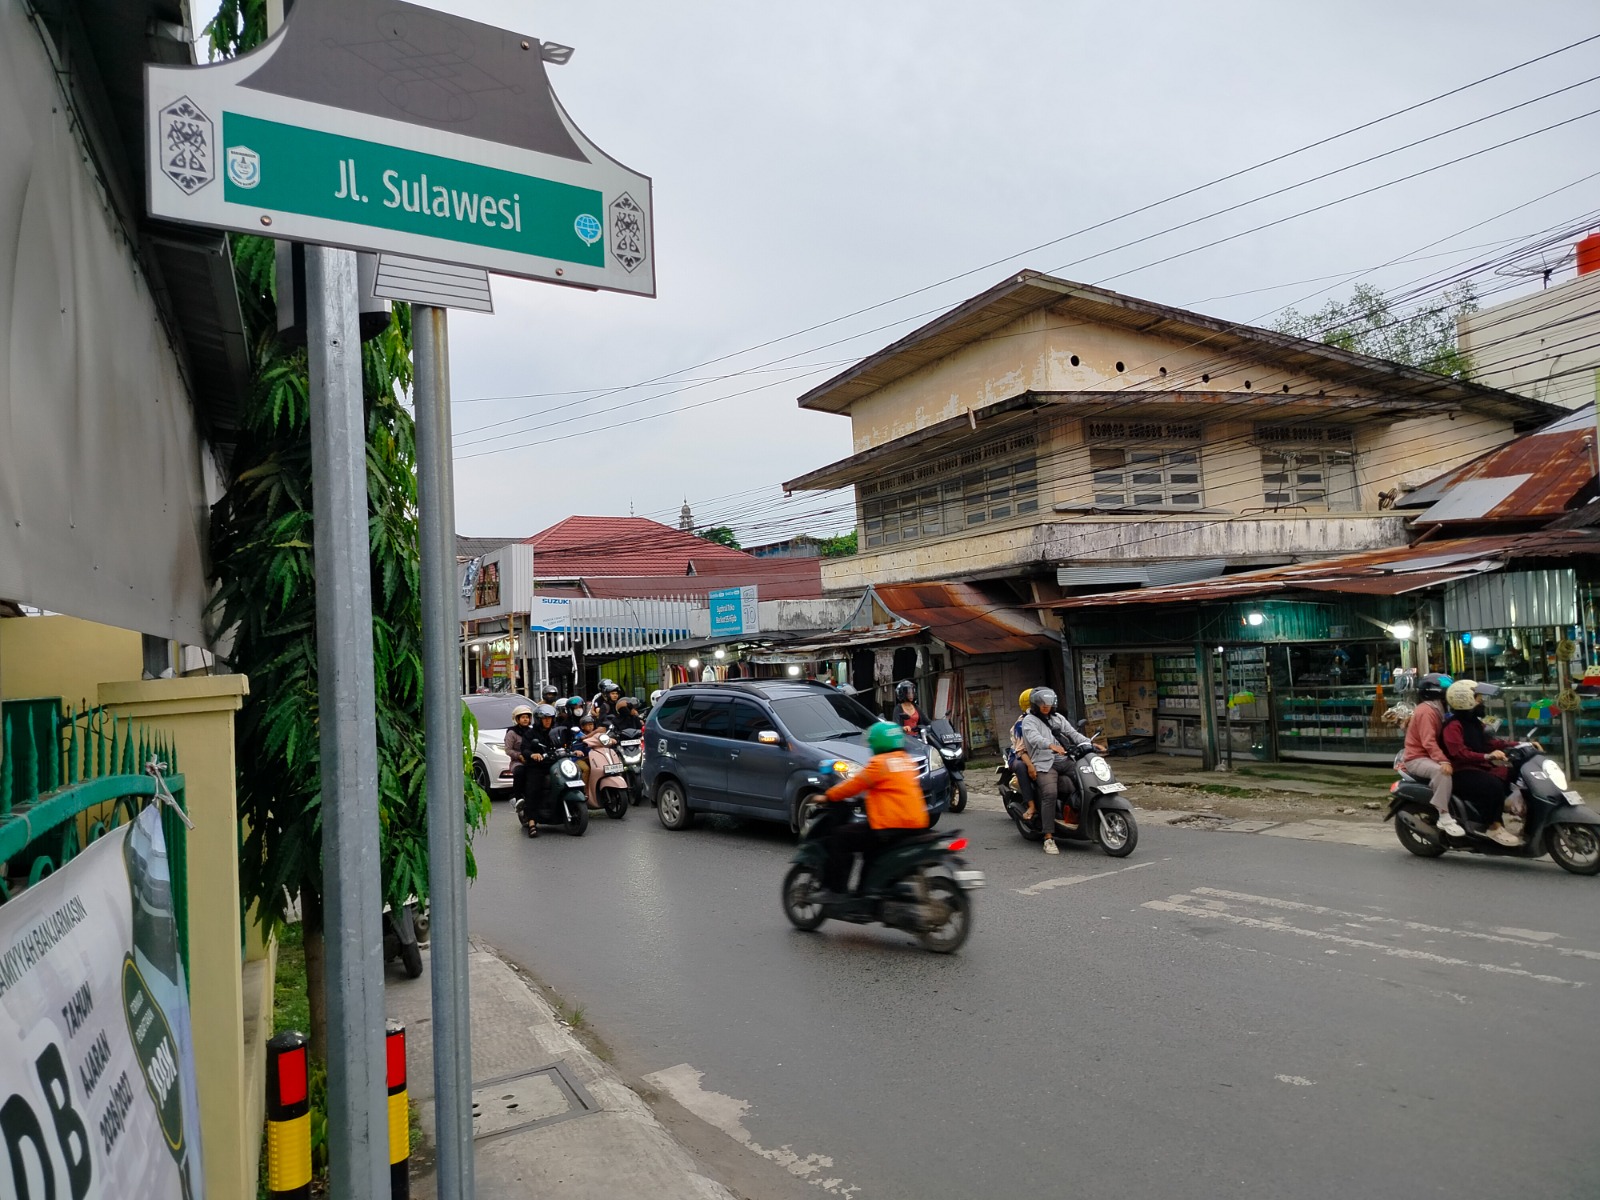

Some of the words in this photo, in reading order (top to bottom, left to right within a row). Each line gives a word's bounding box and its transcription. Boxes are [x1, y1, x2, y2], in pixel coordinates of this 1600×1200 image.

[334, 158, 369, 203] Jl.
[382, 169, 522, 233] Sulawesi
[32, 894, 88, 957] BANJARMASIN
[61, 980, 94, 1039] TAHUN
[79, 1028, 112, 1099] AJARAN
[147, 1036, 178, 1110] 100K
[100, 1069, 135, 1157] 2026/2027
